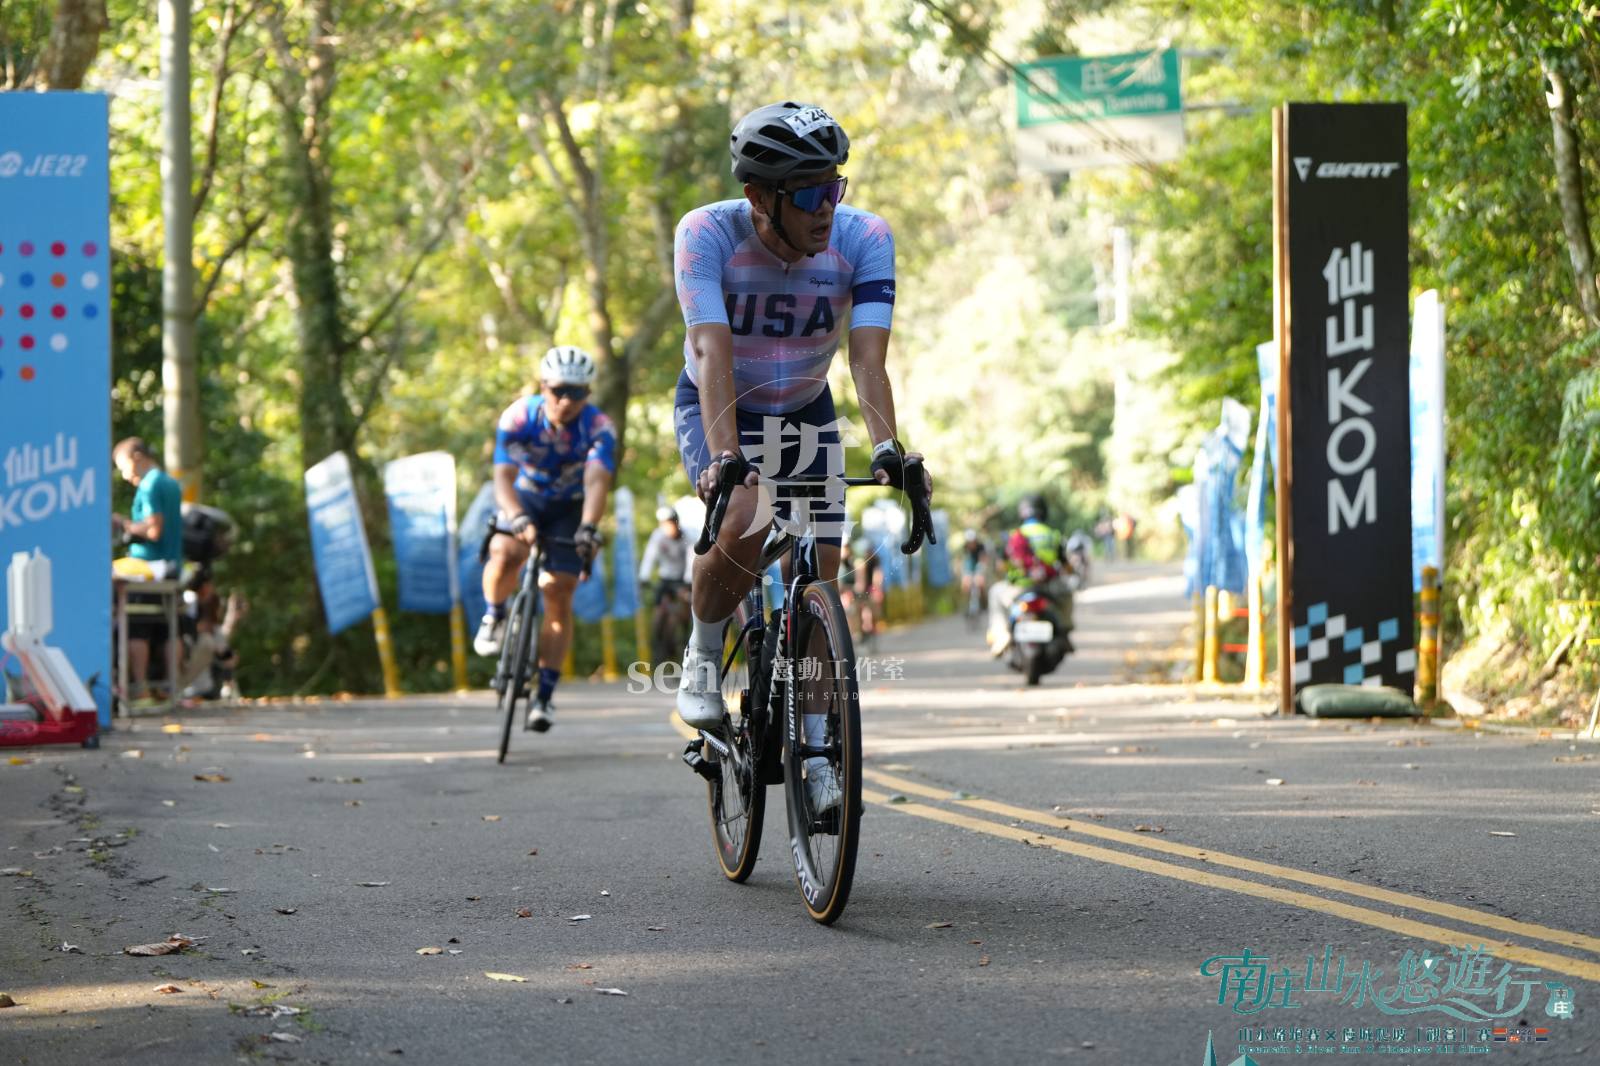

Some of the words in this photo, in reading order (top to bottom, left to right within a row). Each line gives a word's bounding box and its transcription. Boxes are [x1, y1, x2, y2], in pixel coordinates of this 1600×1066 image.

[23, 153, 88, 177] JE22
[1316, 161, 1400, 179] GIANT
[725, 293, 835, 338] USA
[3, 431, 78, 488] 仙山
[0, 466, 96, 531] KOM
